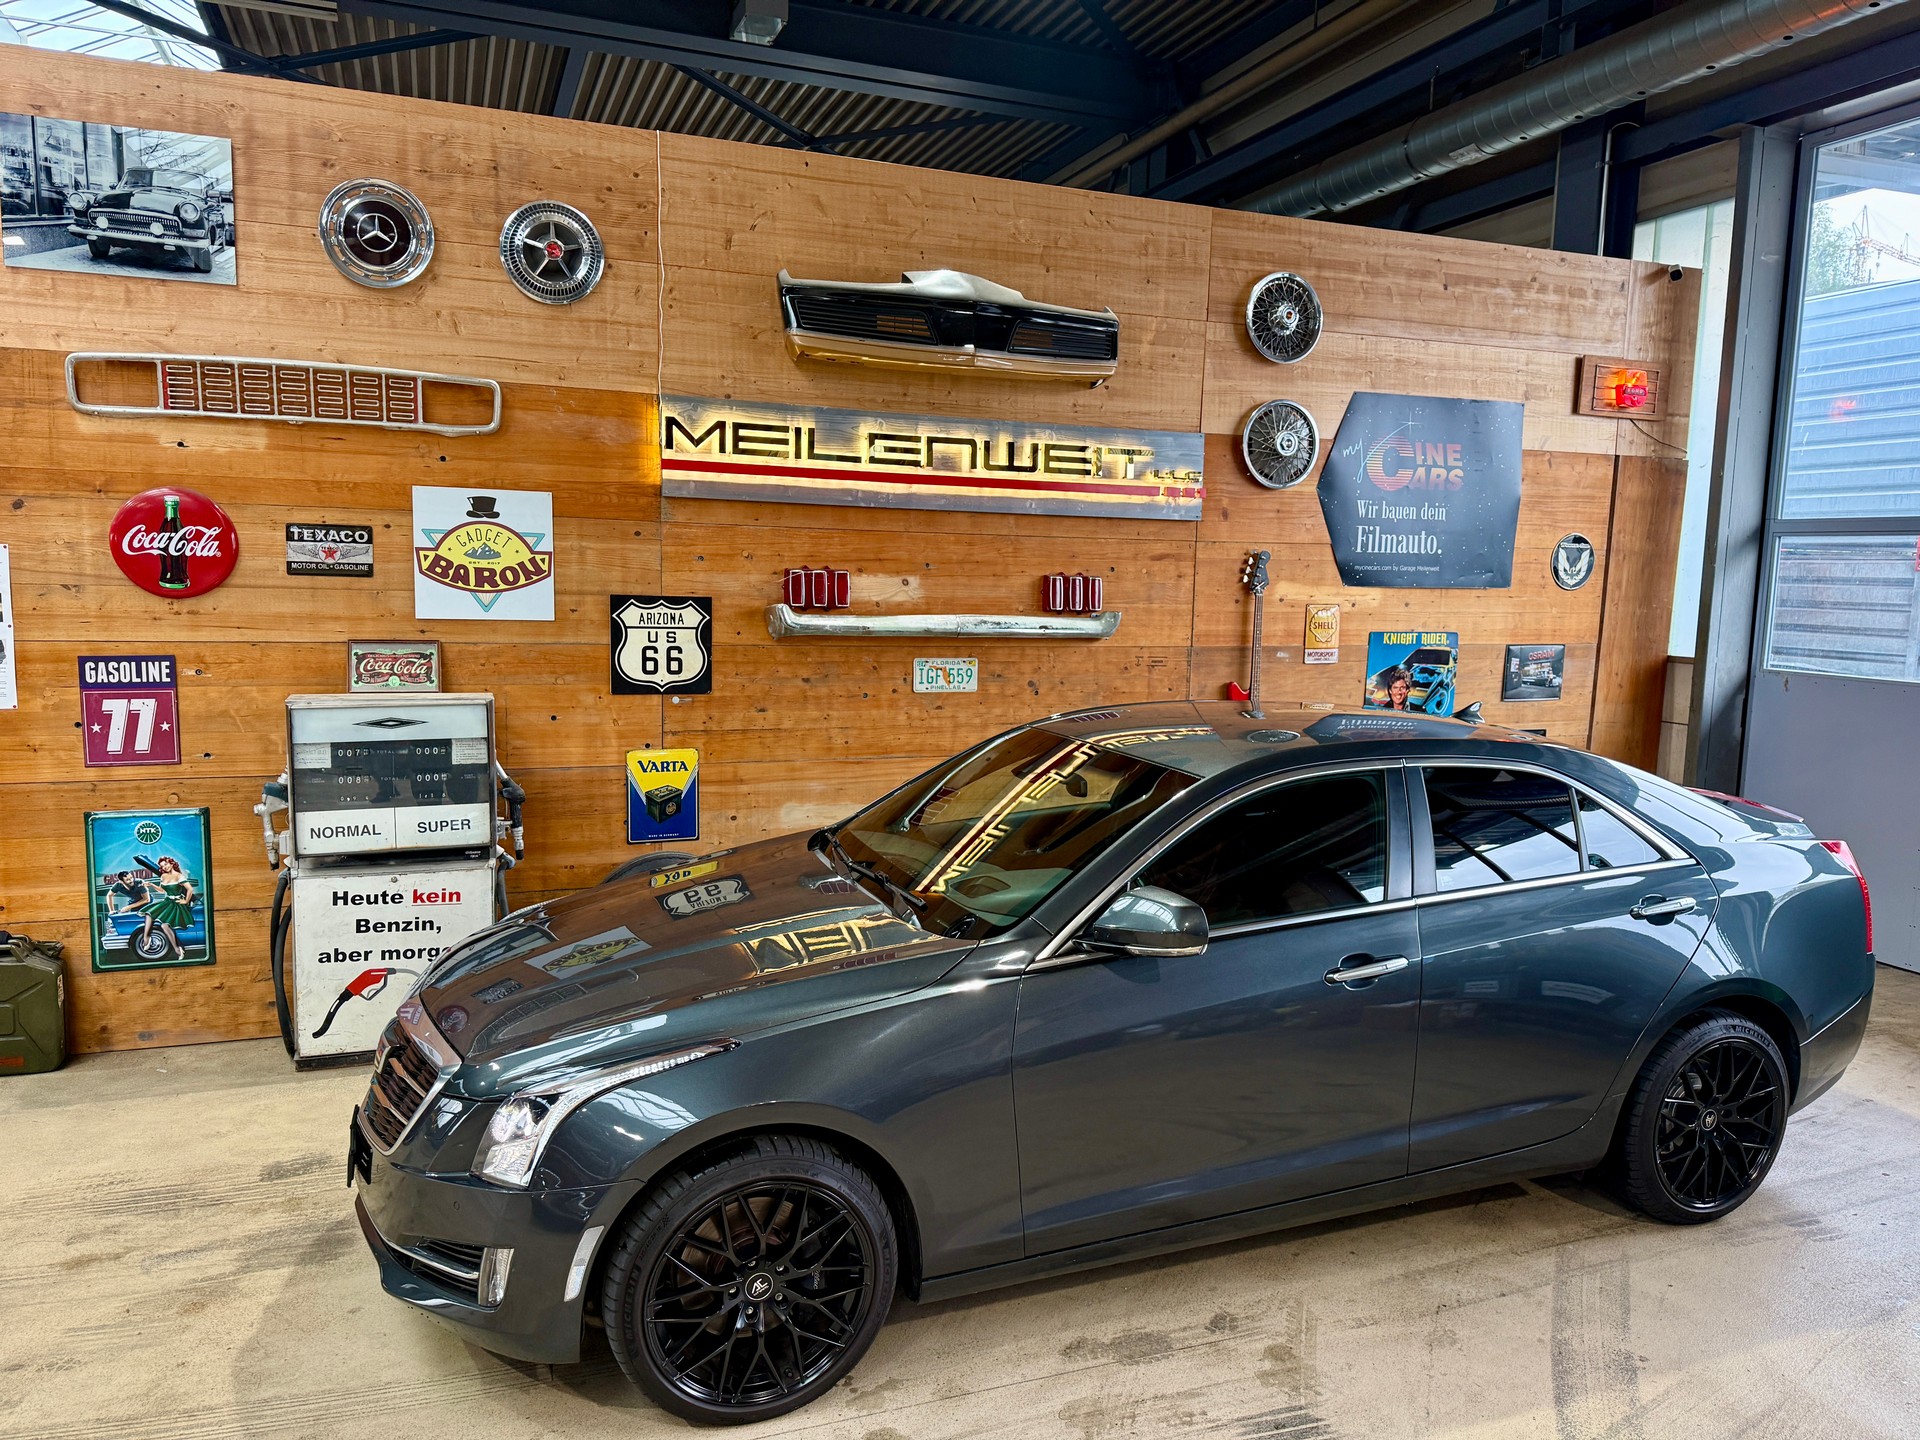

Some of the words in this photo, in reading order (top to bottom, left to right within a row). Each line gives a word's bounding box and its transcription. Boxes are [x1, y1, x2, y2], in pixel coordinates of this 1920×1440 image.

[665, 416, 1154, 479] MEILENWEIT
[1357, 499, 1379, 519] Wir
[1381, 500, 1417, 520] bauen
[1420, 502, 1446, 521] dein
[290, 525, 369, 543] TEXACO
[455, 528, 513, 548] GADGET
[1355, 525, 1442, 555] Filmauto.
[291, 562, 316, 570] MOTOR
[334, 563, 369, 571] GASOLINE
[424, 552, 547, 589] BARON
[1354, 564, 1392, 572] mycinecars.com
[1393, 563, 1398, 572] by
[1399, 564, 1416, 572] Garage
[638, 612, 685, 626] ARIZONA
[1313, 621, 1335, 630] SHELL
[1383, 632, 1419, 646] KNIGHT
[641, 645, 683, 676] 66
[1528, 648, 1555, 660] OSRAM
[84, 661, 171, 683] GASOLINE
[360, 657, 431, 674] Coca-Cola
[948, 667, 973, 685] 559
[101, 698, 158, 754] 77
[637, 759, 689, 773] VARTA
[310, 824, 382, 840] NORMAL
[417, 818, 471, 834] SUPER
[332, 889, 404, 906] Heute
[412, 888, 462, 905] kein
[355, 917, 442, 934] Benzin,
[317, 947, 373, 964] aber
[1735, 1025, 1770, 1046] MICHELIN
[623, 1267, 641, 1341] MICHELIN
